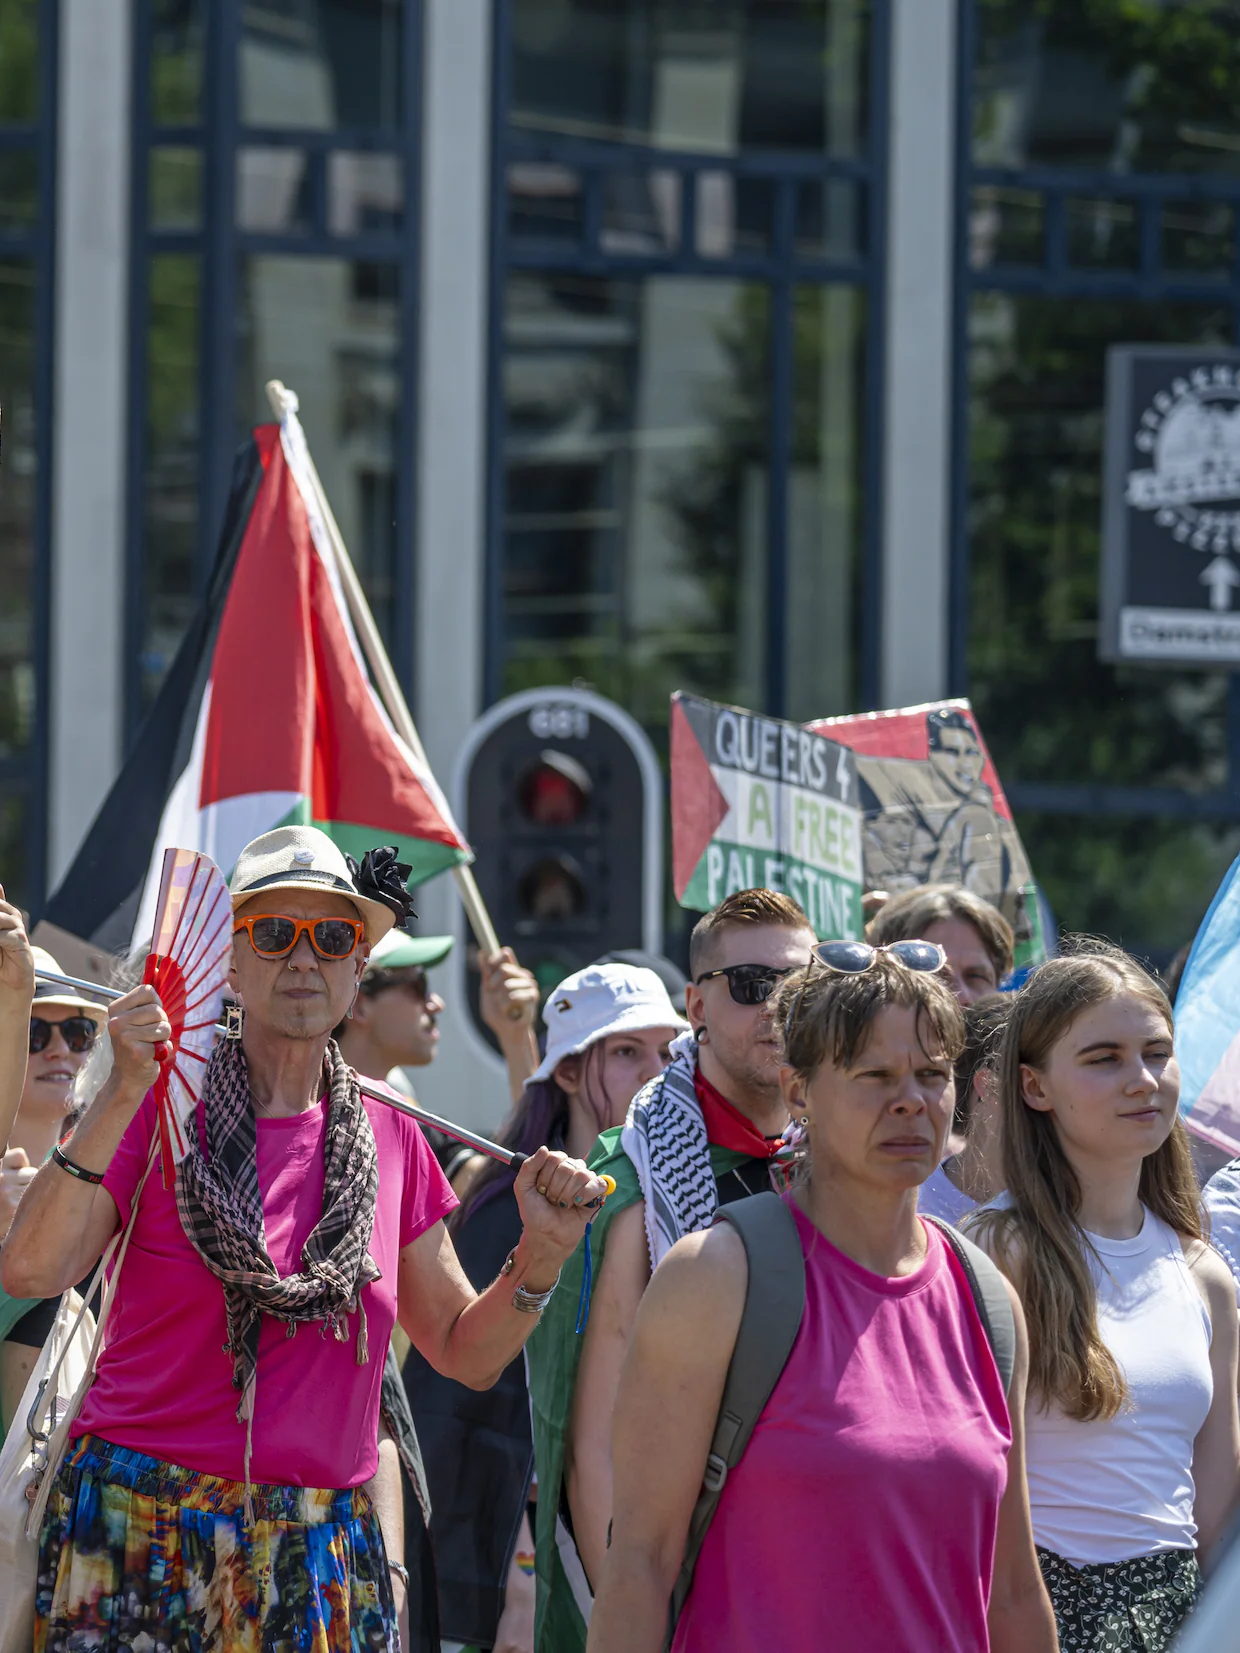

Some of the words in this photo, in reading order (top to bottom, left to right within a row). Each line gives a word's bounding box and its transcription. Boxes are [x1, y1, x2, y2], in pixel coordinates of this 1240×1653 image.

[716, 711, 827, 790] QUEERS
[836, 748, 851, 802] 4
[747, 783, 774, 838] A
[795, 795, 855, 873] FREE
